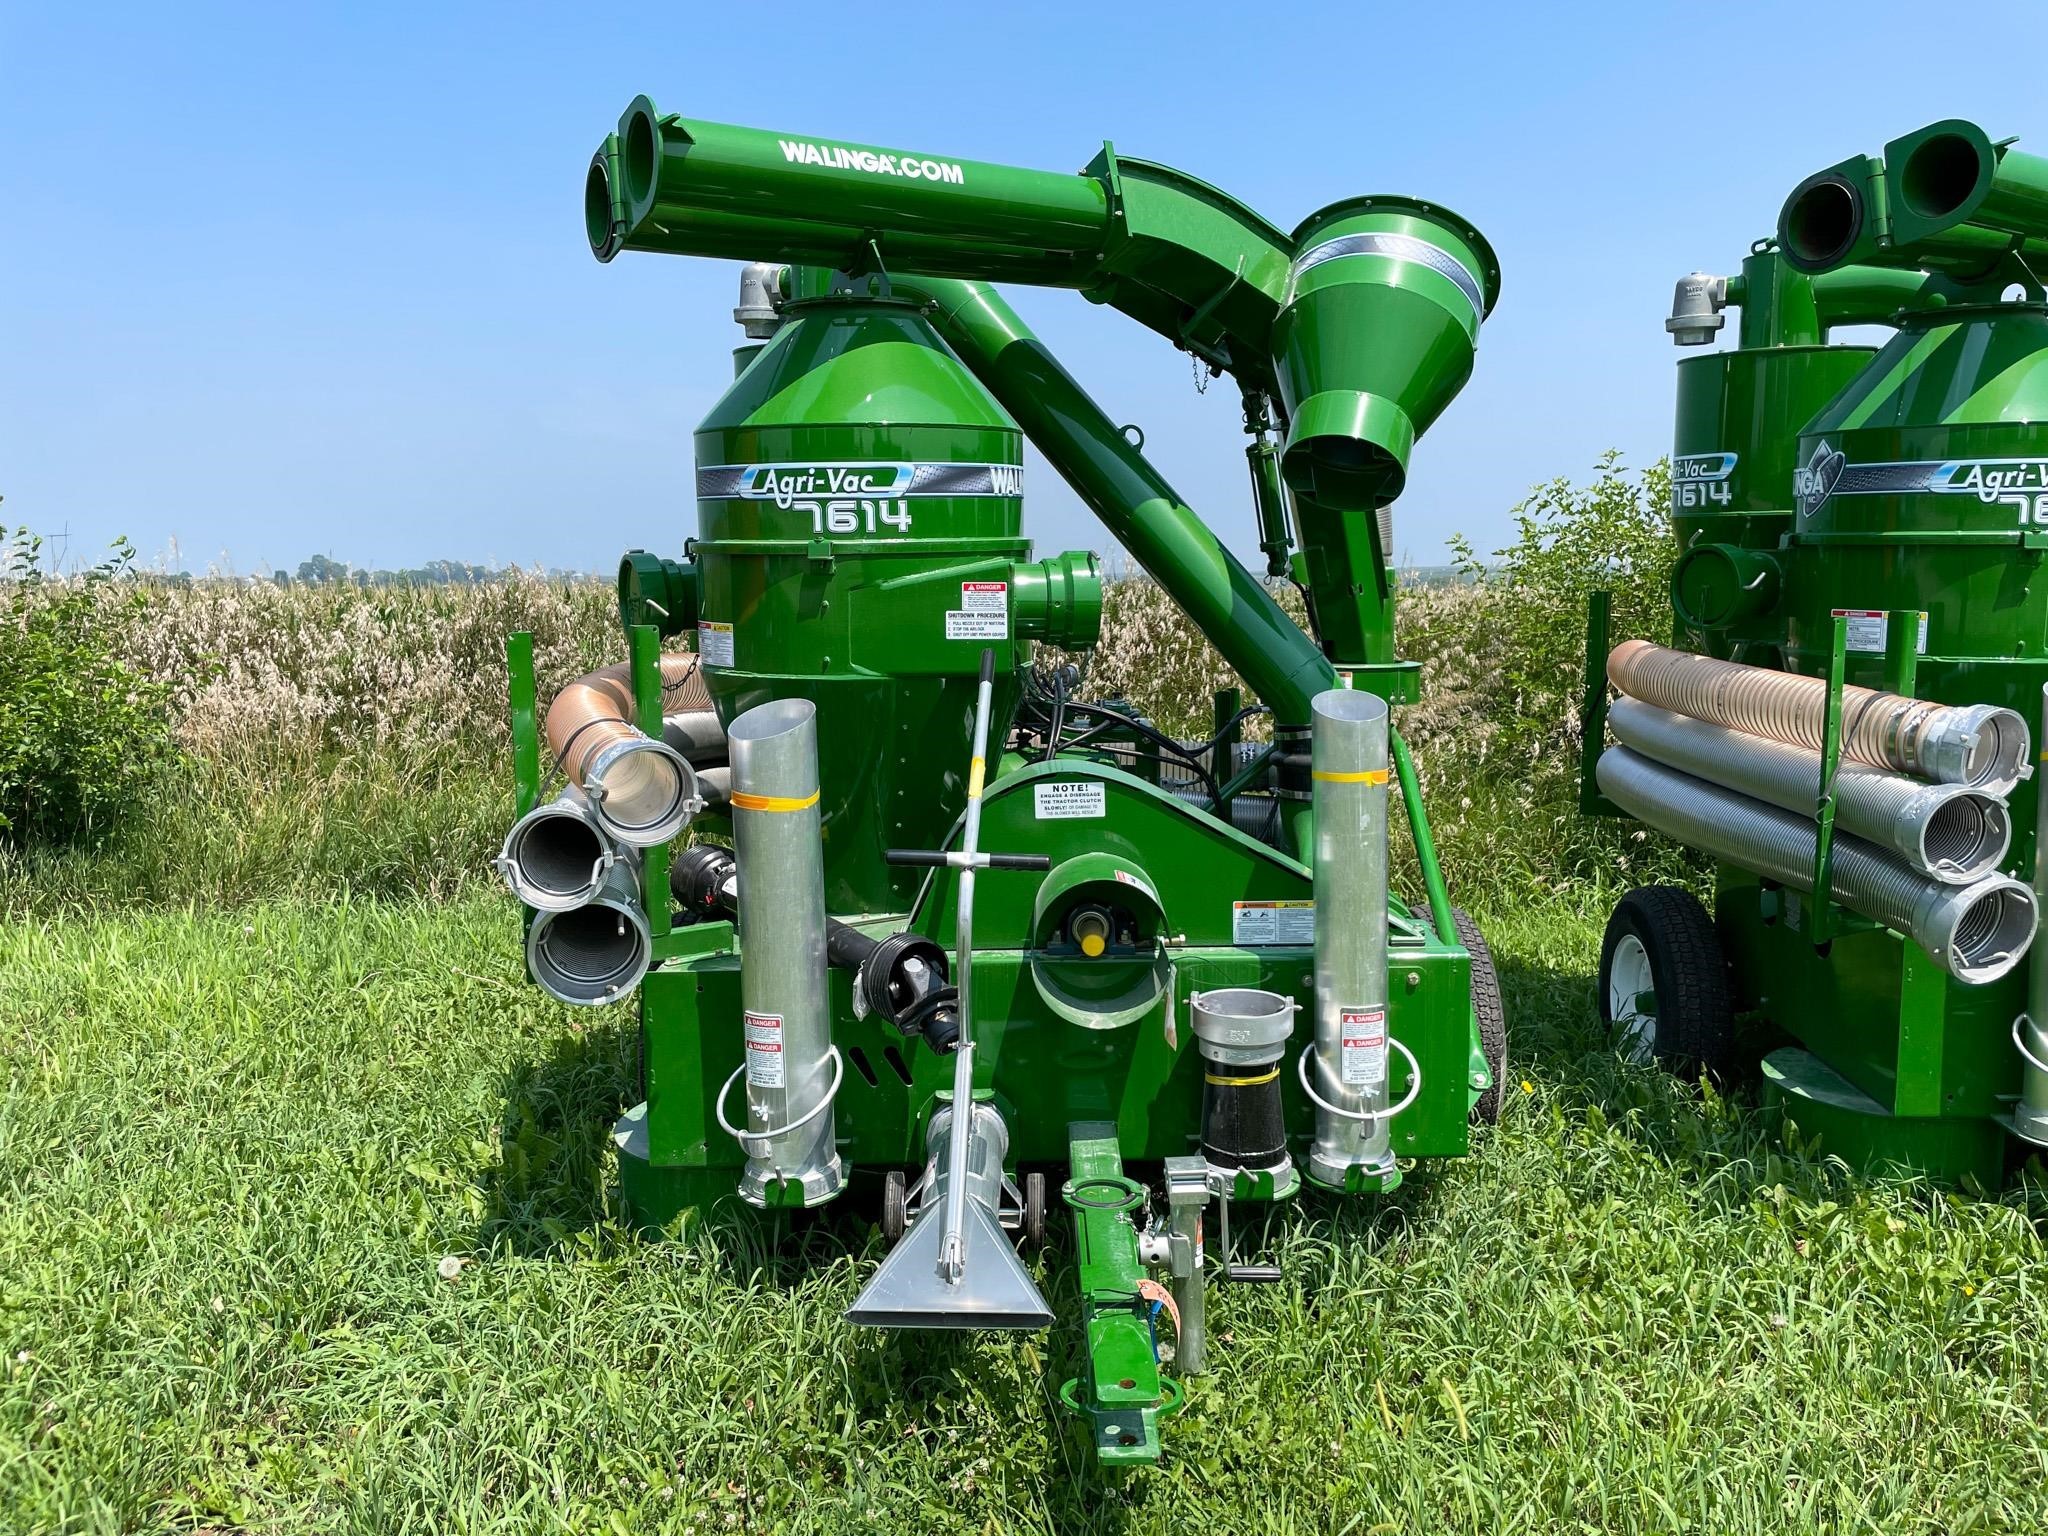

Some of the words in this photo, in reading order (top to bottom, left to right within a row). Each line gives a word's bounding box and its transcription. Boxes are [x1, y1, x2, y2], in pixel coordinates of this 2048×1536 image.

[757, 467, 878, 510] Agri-Vac
[792, 500, 913, 533] 7614
[1053, 784, 1088, 792] NOTE!
[752, 1018, 776, 1026] DANGER
[1357, 1014, 1381, 1022] DANGER
[754, 1043, 778, 1051] DANGER
